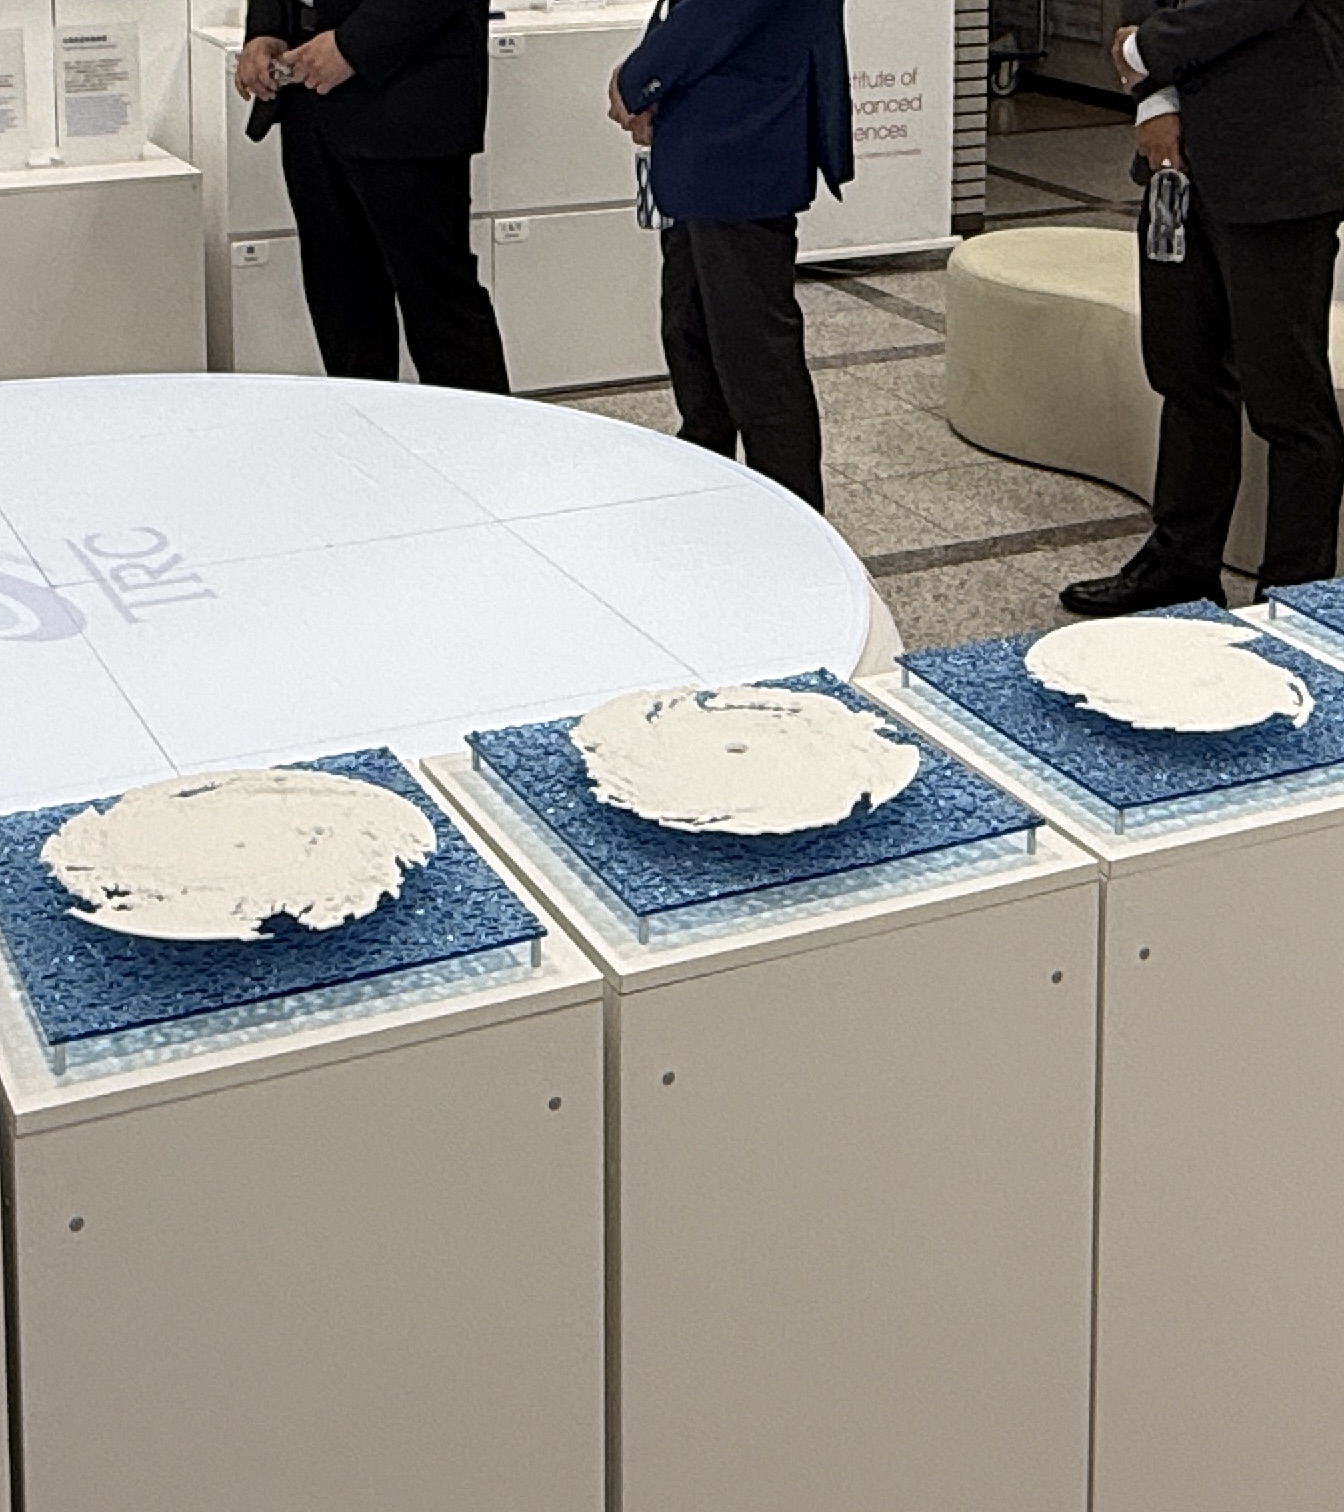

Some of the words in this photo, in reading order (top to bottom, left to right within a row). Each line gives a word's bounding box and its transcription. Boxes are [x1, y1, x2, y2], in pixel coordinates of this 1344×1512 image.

[853, 71, 895, 88] titute
[901, 67, 917, 86] of
[854, 94, 922, 114] vanced
[854, 125, 907, 141] ences
